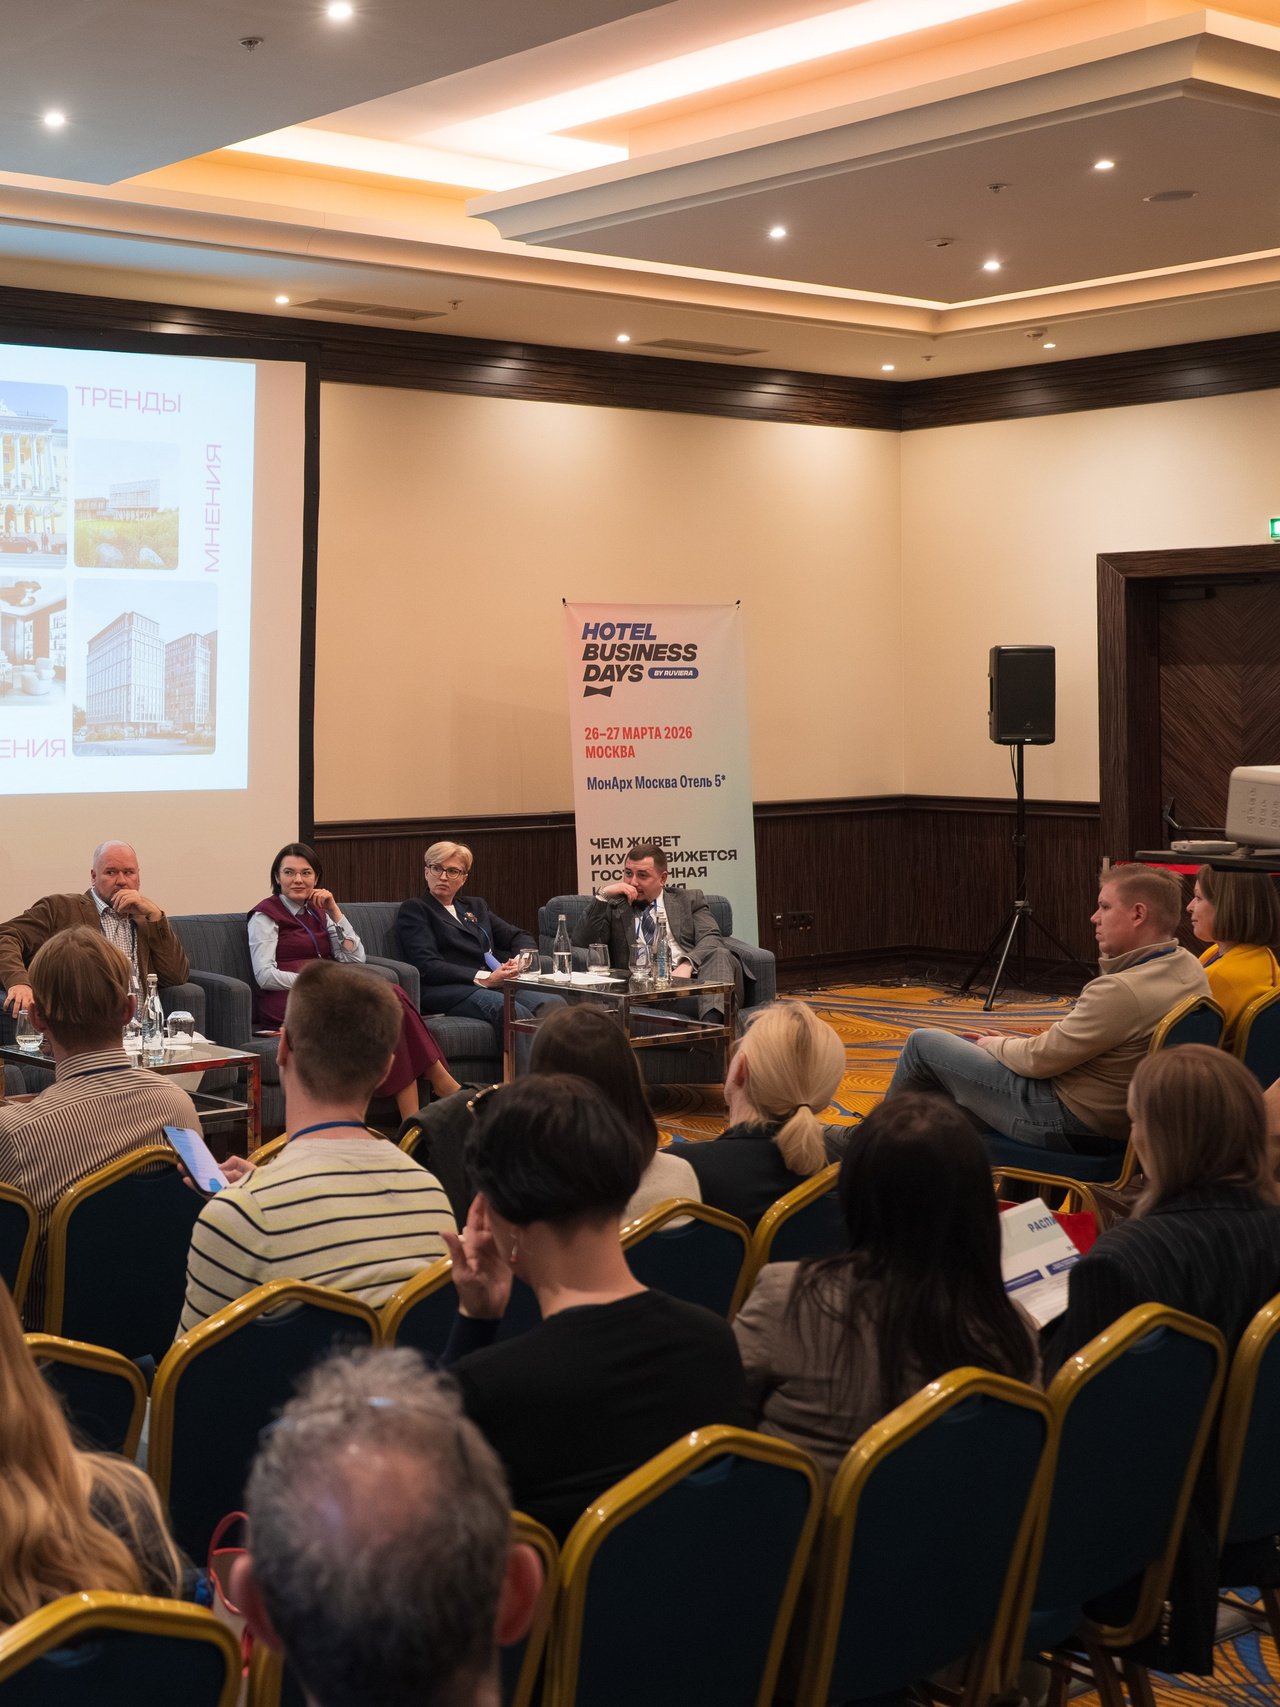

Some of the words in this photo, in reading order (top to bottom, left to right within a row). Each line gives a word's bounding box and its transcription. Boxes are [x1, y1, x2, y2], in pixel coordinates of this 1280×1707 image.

[74, 385, 182, 415] ТРЕНДЫ
[203, 443, 222, 573] МНЕНИЯ
[581, 622, 657, 641] HOTEL
[582, 643, 698, 662] BUSINESS
[583, 664, 644, 682] DAYS
[622, 726, 662, 740] МАРТА
[664, 726, 693, 739] 2026
[585, 745, 636, 758] МОСКВА
[587, 776, 633, 792] МонАрх
[635, 775, 677, 789] Москва
[680, 774, 712, 788] Отель
[590, 838, 624, 849] ЧЕМ
[591, 854, 602, 865] И
[605, 853, 626, 865] КУ
[665, 849, 738, 862] ВИЖЕТСЯ
